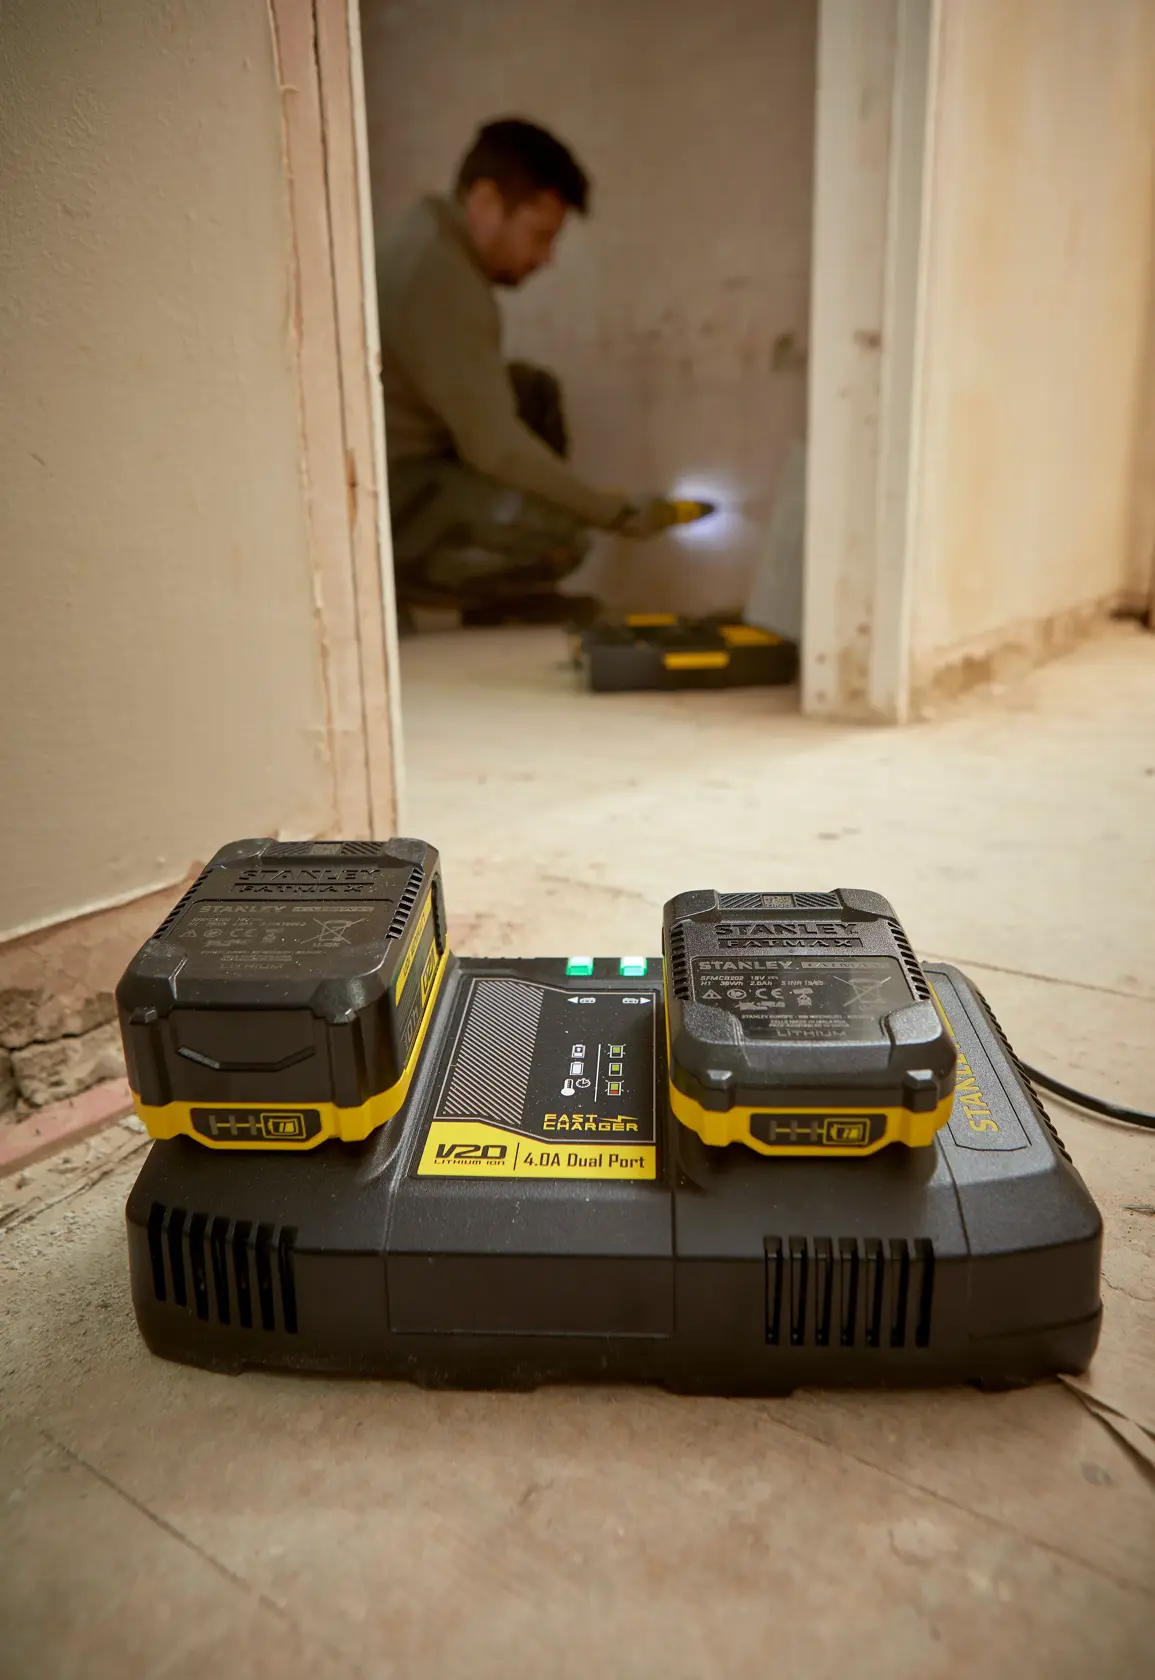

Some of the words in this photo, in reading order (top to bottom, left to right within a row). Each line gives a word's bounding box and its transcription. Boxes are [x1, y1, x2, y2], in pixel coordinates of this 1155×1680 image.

[238, 869, 381, 881] STANLEY
[239, 885, 363, 893] FATMAX
[200, 905, 287, 913] STANLEY
[714, 923, 859, 936] STANLEY
[725, 939, 854, 948] FATMAX
[699, 961, 793, 970] STANLEY
[776, 1029, 847, 1037] LITHIUM
[544, 1113, 598, 1123] FAST
[543, 1121, 639, 1132] CHARGER
[435, 1143, 508, 1160] V20
[523, 1152, 561, 1167] 4.0A
[567, 1152, 602, 1168] Dual
[608, 1153, 645, 1169] Port
